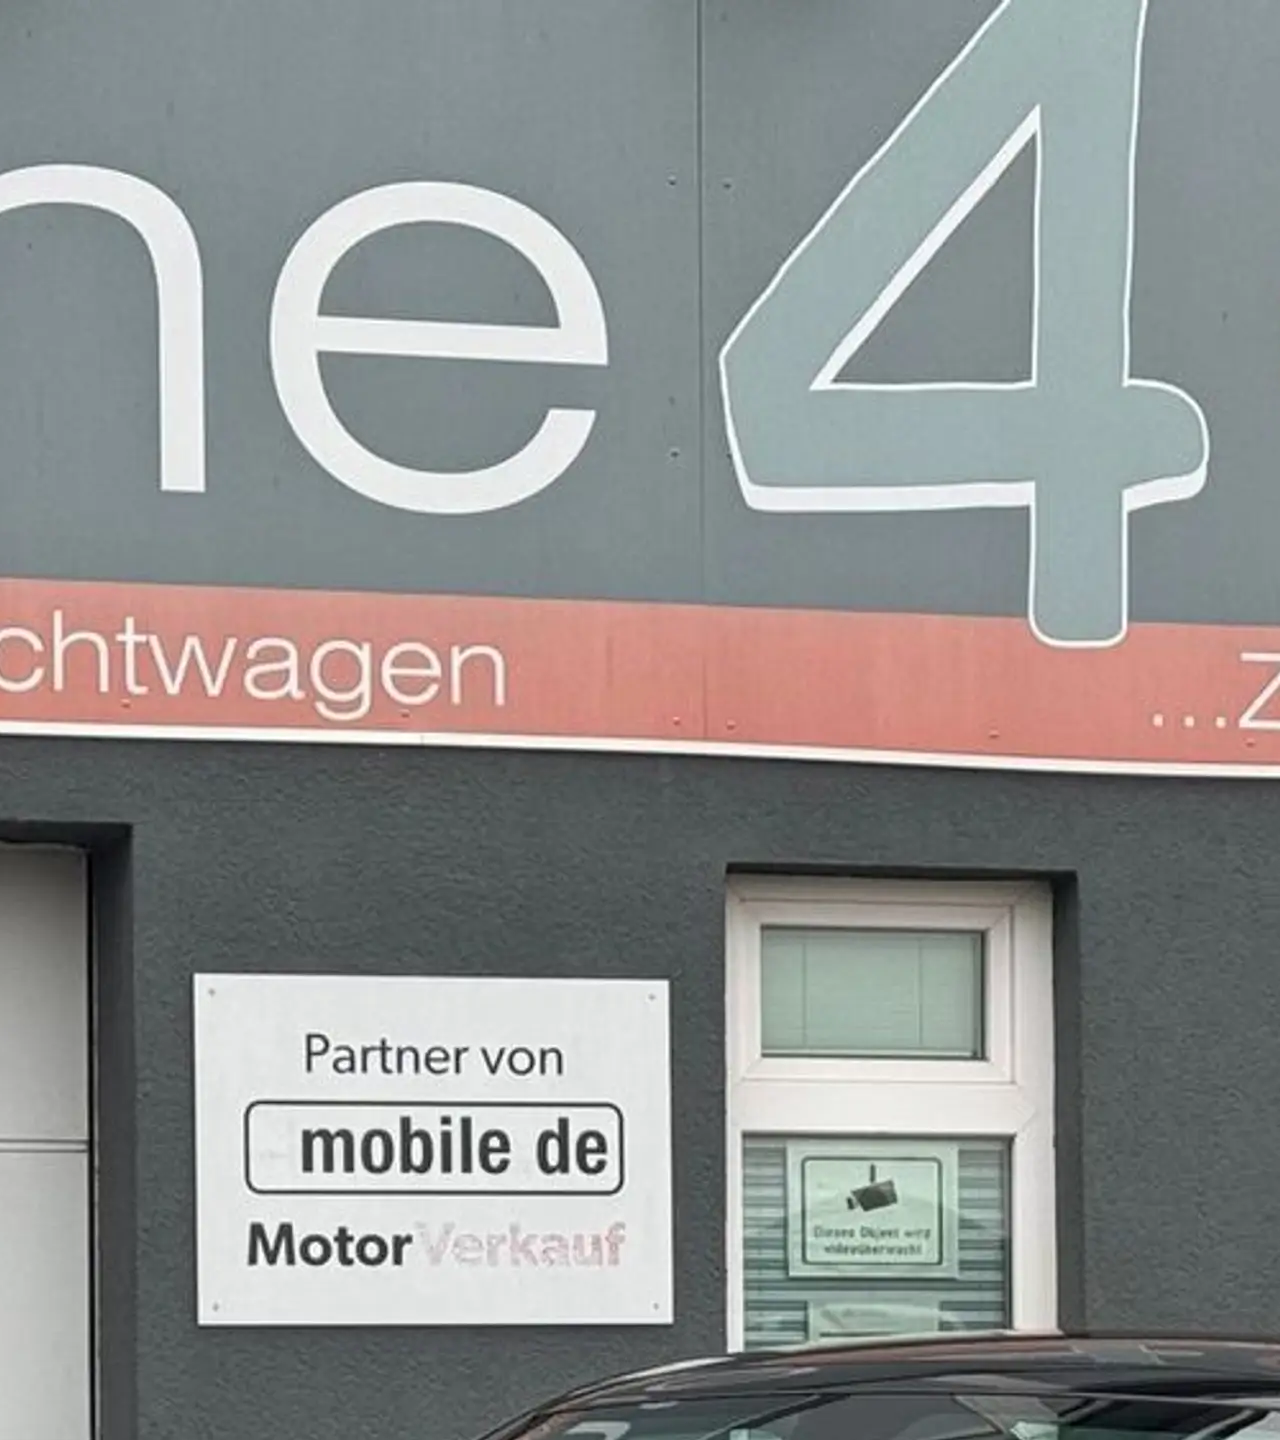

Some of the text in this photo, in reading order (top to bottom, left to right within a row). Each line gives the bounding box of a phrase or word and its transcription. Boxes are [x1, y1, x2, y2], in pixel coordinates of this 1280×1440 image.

[720, 0, 1208, 648] 4
[305, 1033, 563, 1076] Partner von
[301, 1115, 608, 1175] mobile de
